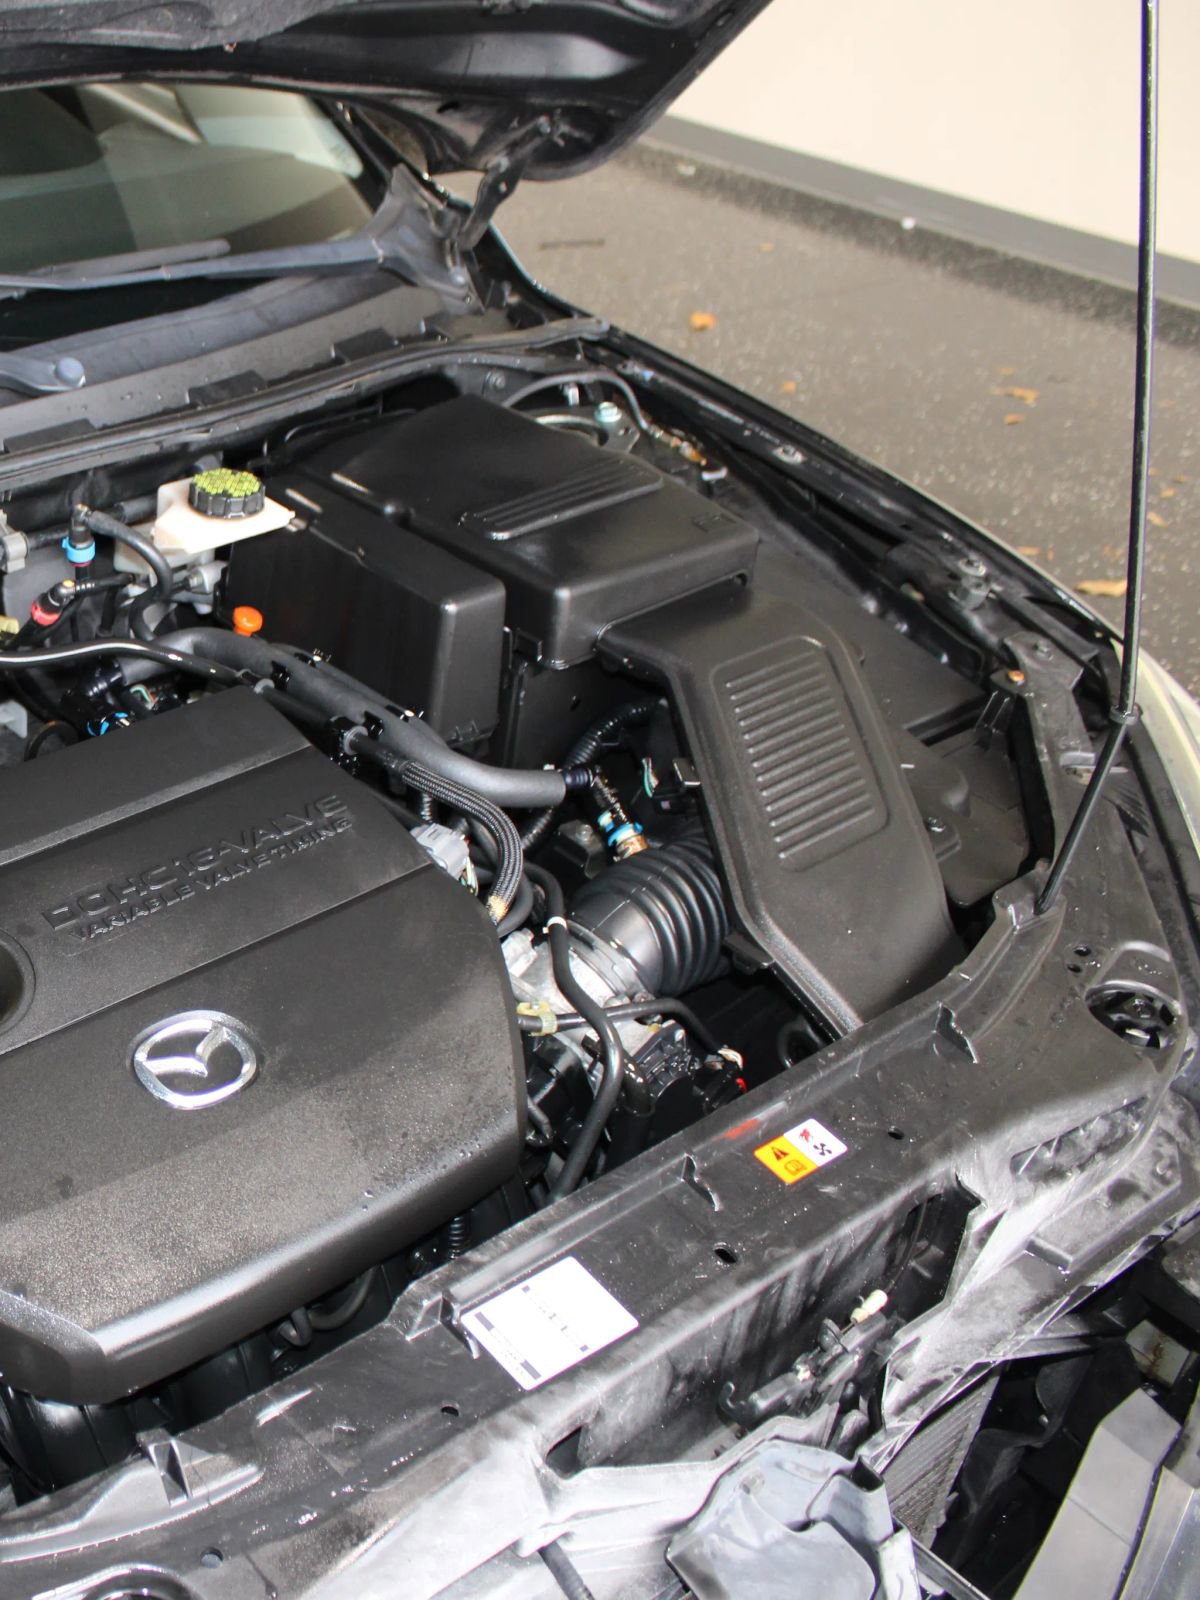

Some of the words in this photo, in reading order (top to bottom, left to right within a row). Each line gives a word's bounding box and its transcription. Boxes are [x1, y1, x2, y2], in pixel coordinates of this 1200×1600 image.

[42, 865, 177, 931] DOHC
[68, 884, 196, 941] VARIABLE
[196, 853, 272, 890] VALVE
[271, 816, 353, 859] TIMING
